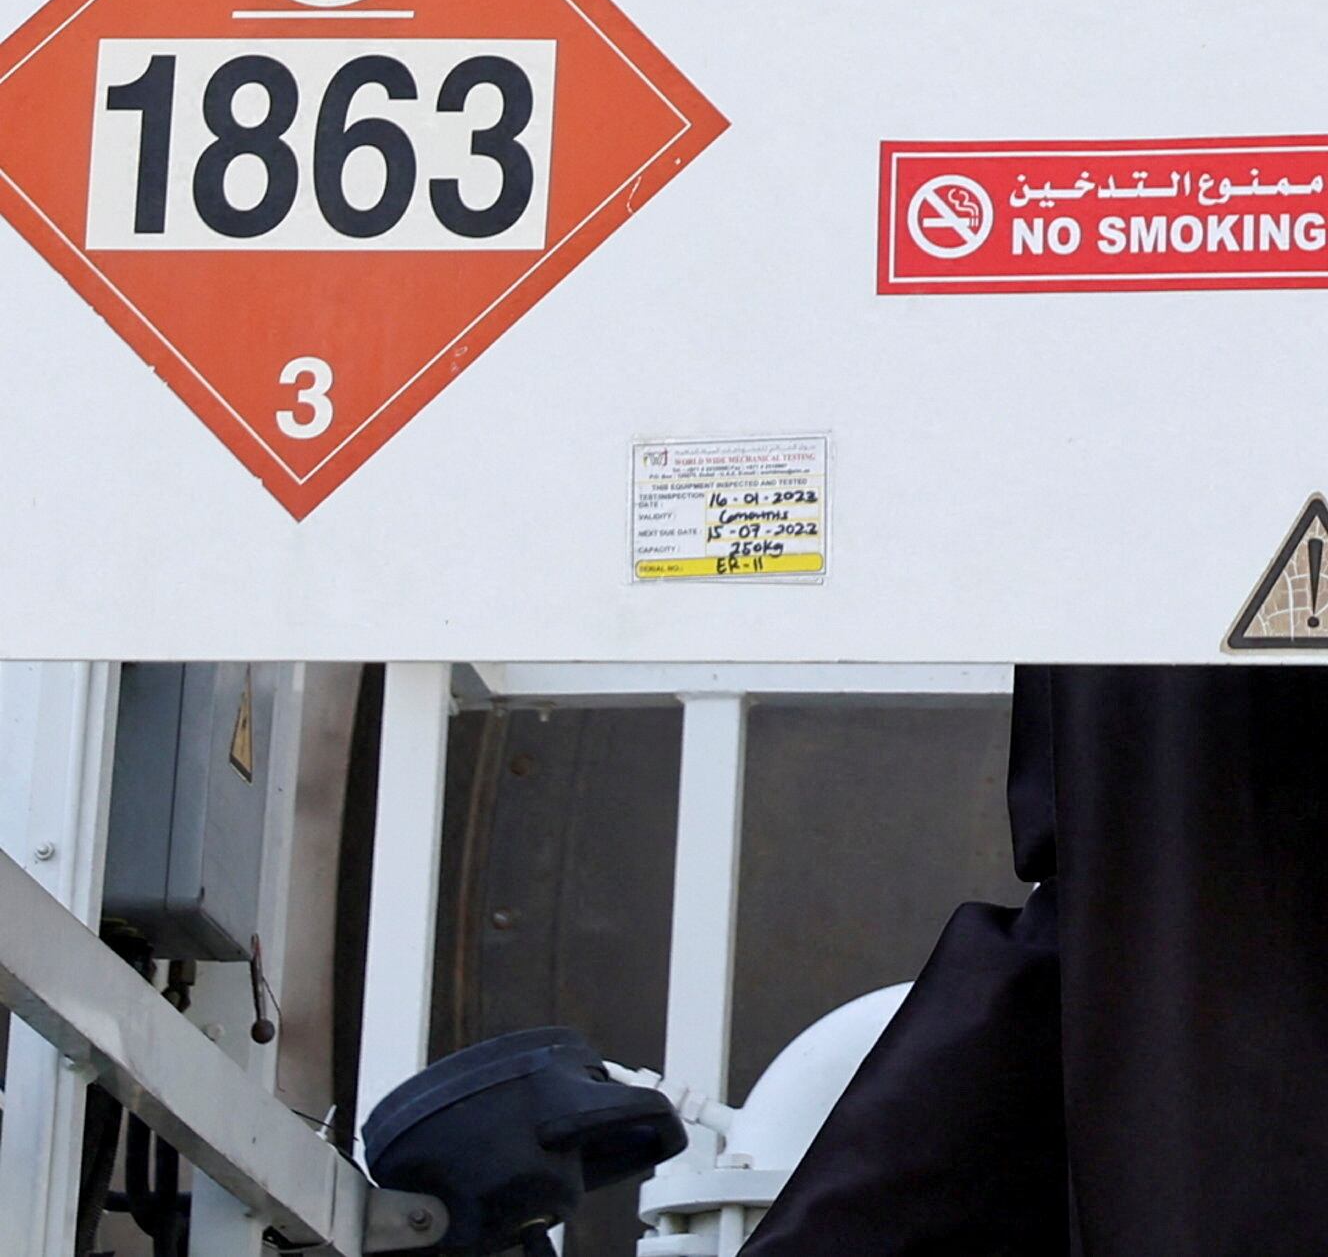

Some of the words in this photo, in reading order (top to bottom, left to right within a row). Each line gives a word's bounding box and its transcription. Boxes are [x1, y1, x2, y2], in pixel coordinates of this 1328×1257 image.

[106, 54, 534, 240] 1863
[1009, 171, 1192, 209] التدخين
[1197, 168, 1324, 206] ممنوع
[1012, 217, 1081, 255] NO
[1097, 212, 1326, 254] SMOKING
[275, 356, 334, 439] 3
[670, 482, 714, 490] EQUIPMENT
[716, 480, 759, 488] INSPECTED
[780, 477, 808, 485] TESTED
